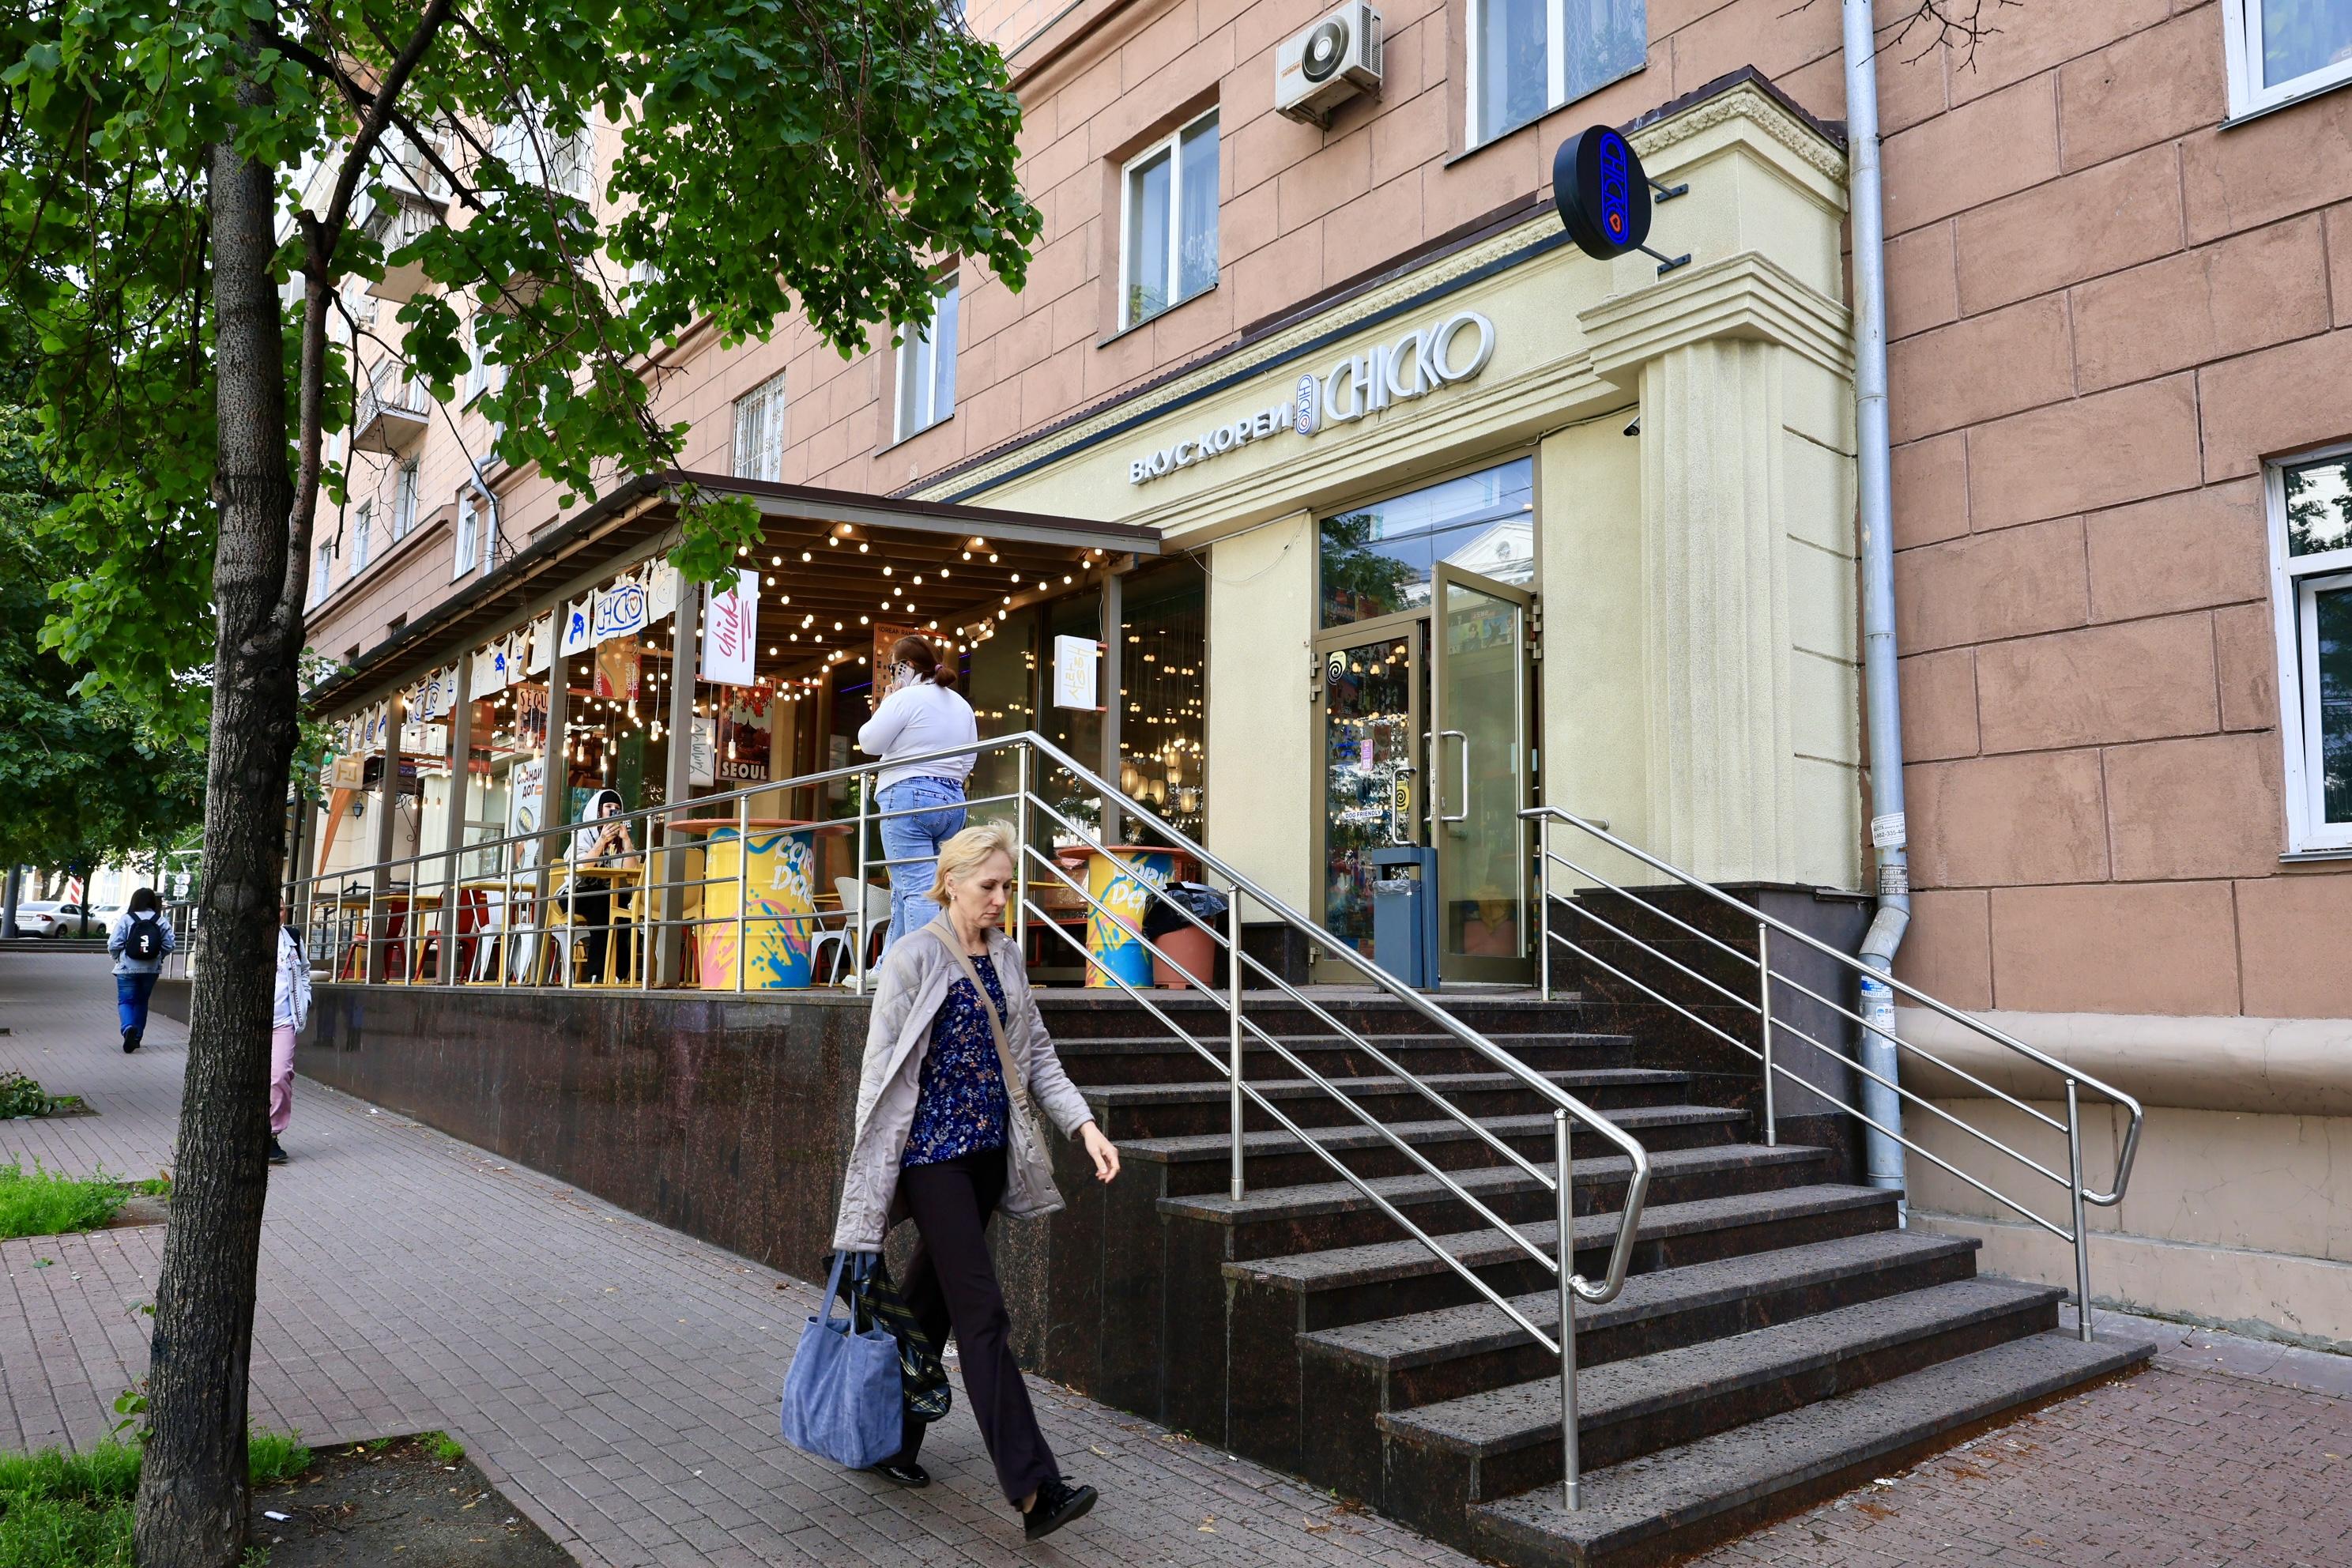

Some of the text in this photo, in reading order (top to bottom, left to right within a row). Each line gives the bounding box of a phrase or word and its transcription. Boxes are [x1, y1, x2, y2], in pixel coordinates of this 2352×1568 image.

[1604, 138, 1626, 240] CHICKO
[1324, 311, 1495, 423] CHICKO
[1298, 377, 1311, 432] CHICKO
[1129, 401, 1294, 486] ВКУС КОРЕИ
[597, 589, 643, 630] CHCKO
[520, 692, 547, 708] SEOU
[517, 767, 542, 785] САНДИ
[722, 761, 767, 780] SEOUL
[522, 784, 535, 800] ДОГ
[775, 835, 813, 876] COR
[770, 865, 814, 906] DOG
[1112, 883, 1146, 912] DO
[139, 935, 149, 953] FILA
